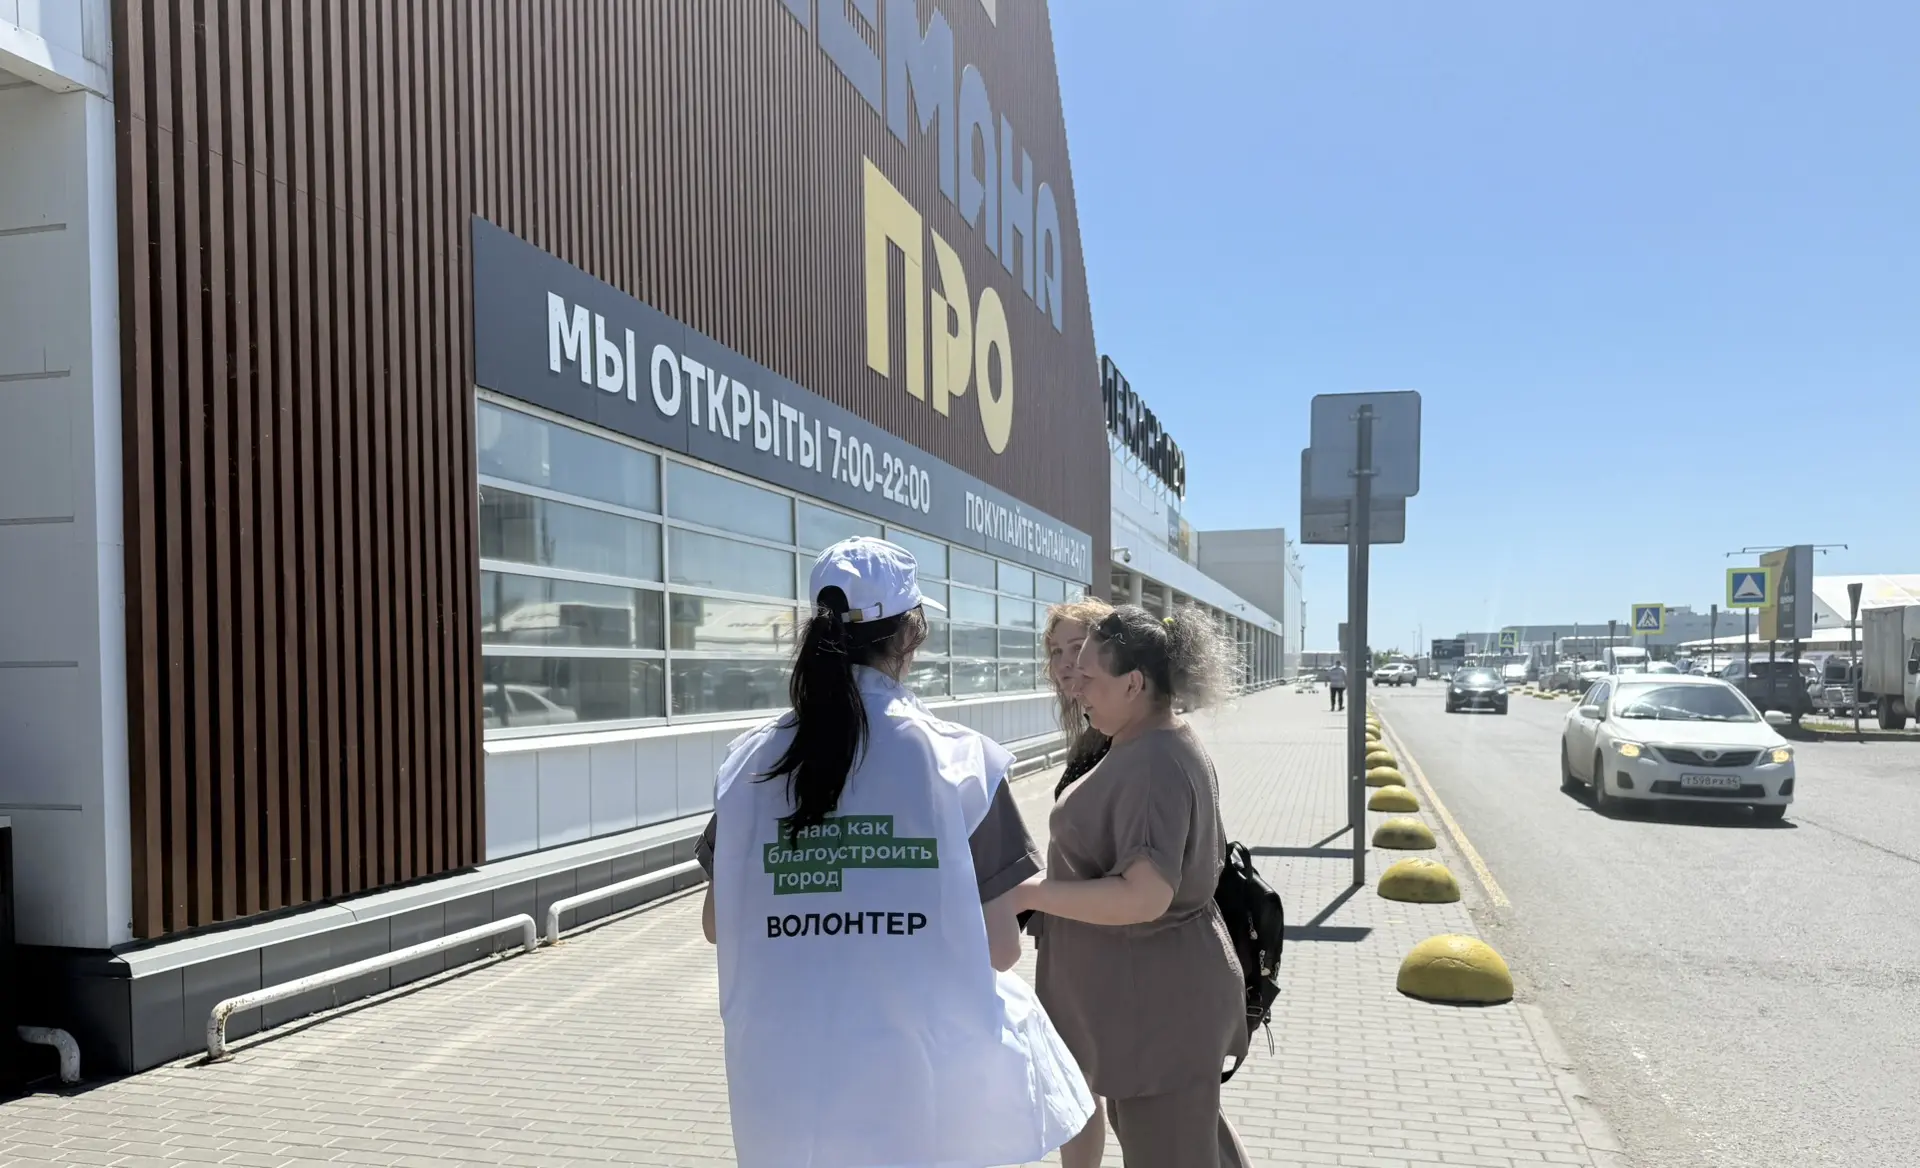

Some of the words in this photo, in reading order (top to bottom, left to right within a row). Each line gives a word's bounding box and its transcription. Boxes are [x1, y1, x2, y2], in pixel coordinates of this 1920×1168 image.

[863, 154, 1014, 455] ПРО
[547, 291, 637, 401] МЫ
[650, 344, 822, 473] ОТКРЫТЫ
[827, 425, 931, 514] 7:00-22:00
[965, 490, 1034, 553] ПОКУПАЙТЕ
[1034, 523, 1071, 566] ОНЛАЙН
[848, 821, 889, 836] как
[767, 844, 932, 865] благоустроить
[778, 870, 839, 890] город
[767, 911, 927, 938] ВОЛОНТЕР
